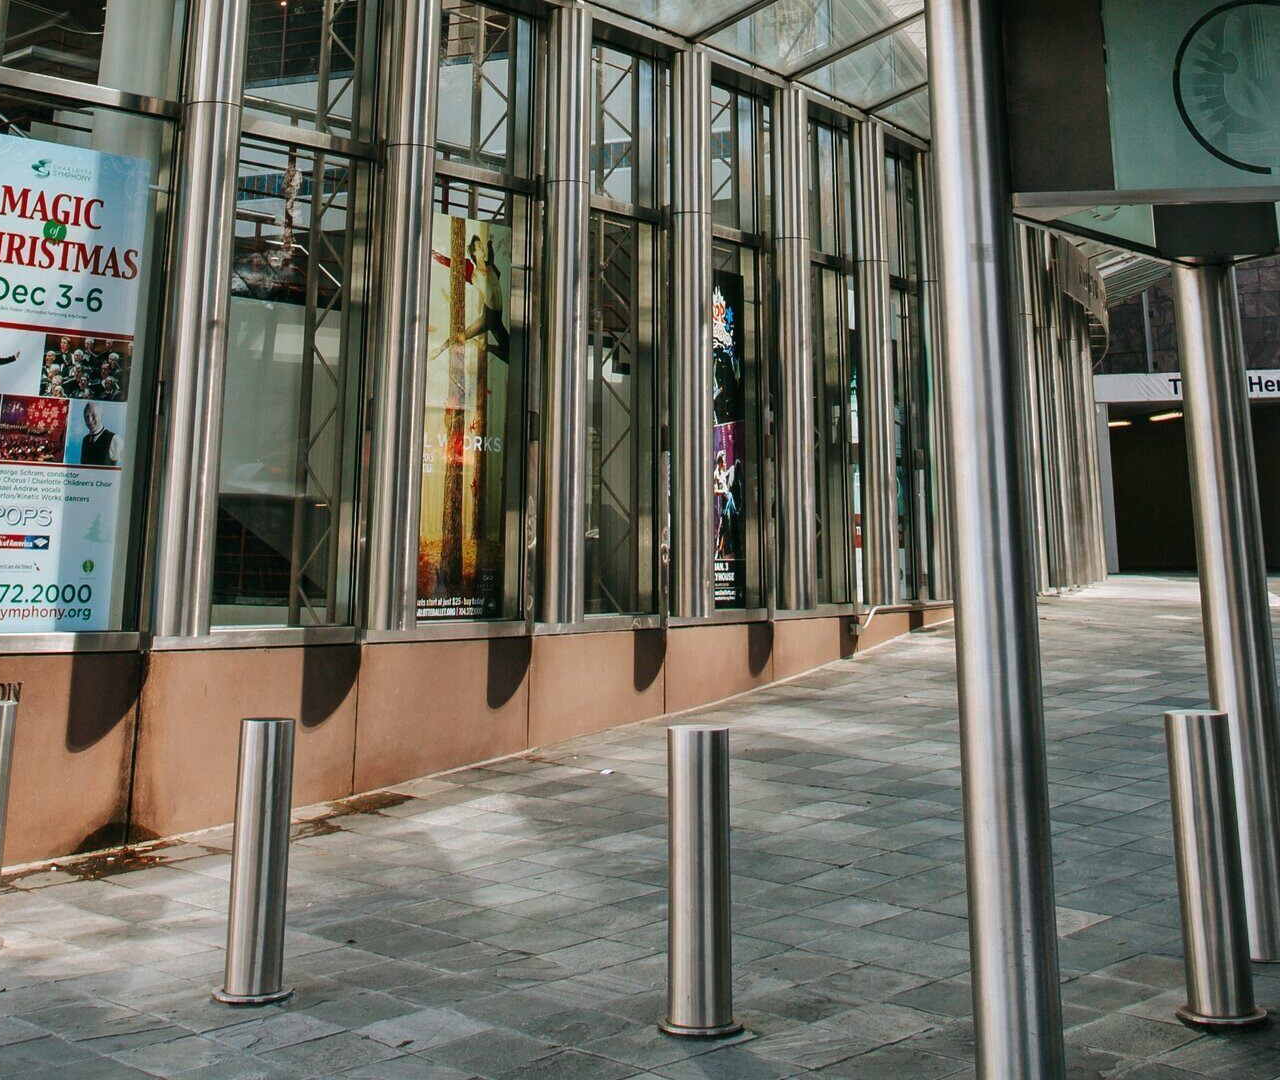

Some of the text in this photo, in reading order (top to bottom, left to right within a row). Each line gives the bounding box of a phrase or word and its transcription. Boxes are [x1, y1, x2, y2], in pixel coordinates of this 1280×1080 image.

[52, 170, 92, 182] SYMPHONY
[49, 225, 62, 238] of
[55, 283, 104, 313] 3-6
[20, 469, 45, 478] Schram,
[47, 470, 80, 479] conductor
[3, 475, 26, 484] Chorus
[31, 477, 61, 486] Charlotte
[95, 480, 113, 488] Choir
[13, 485, 39, 493] Andrew,
[40, 486, 61, 494] vocals
[41, 494, 63, 502] Works,
[64, 495, 90, 503] dancers
[9, 539, 33, 548] America
